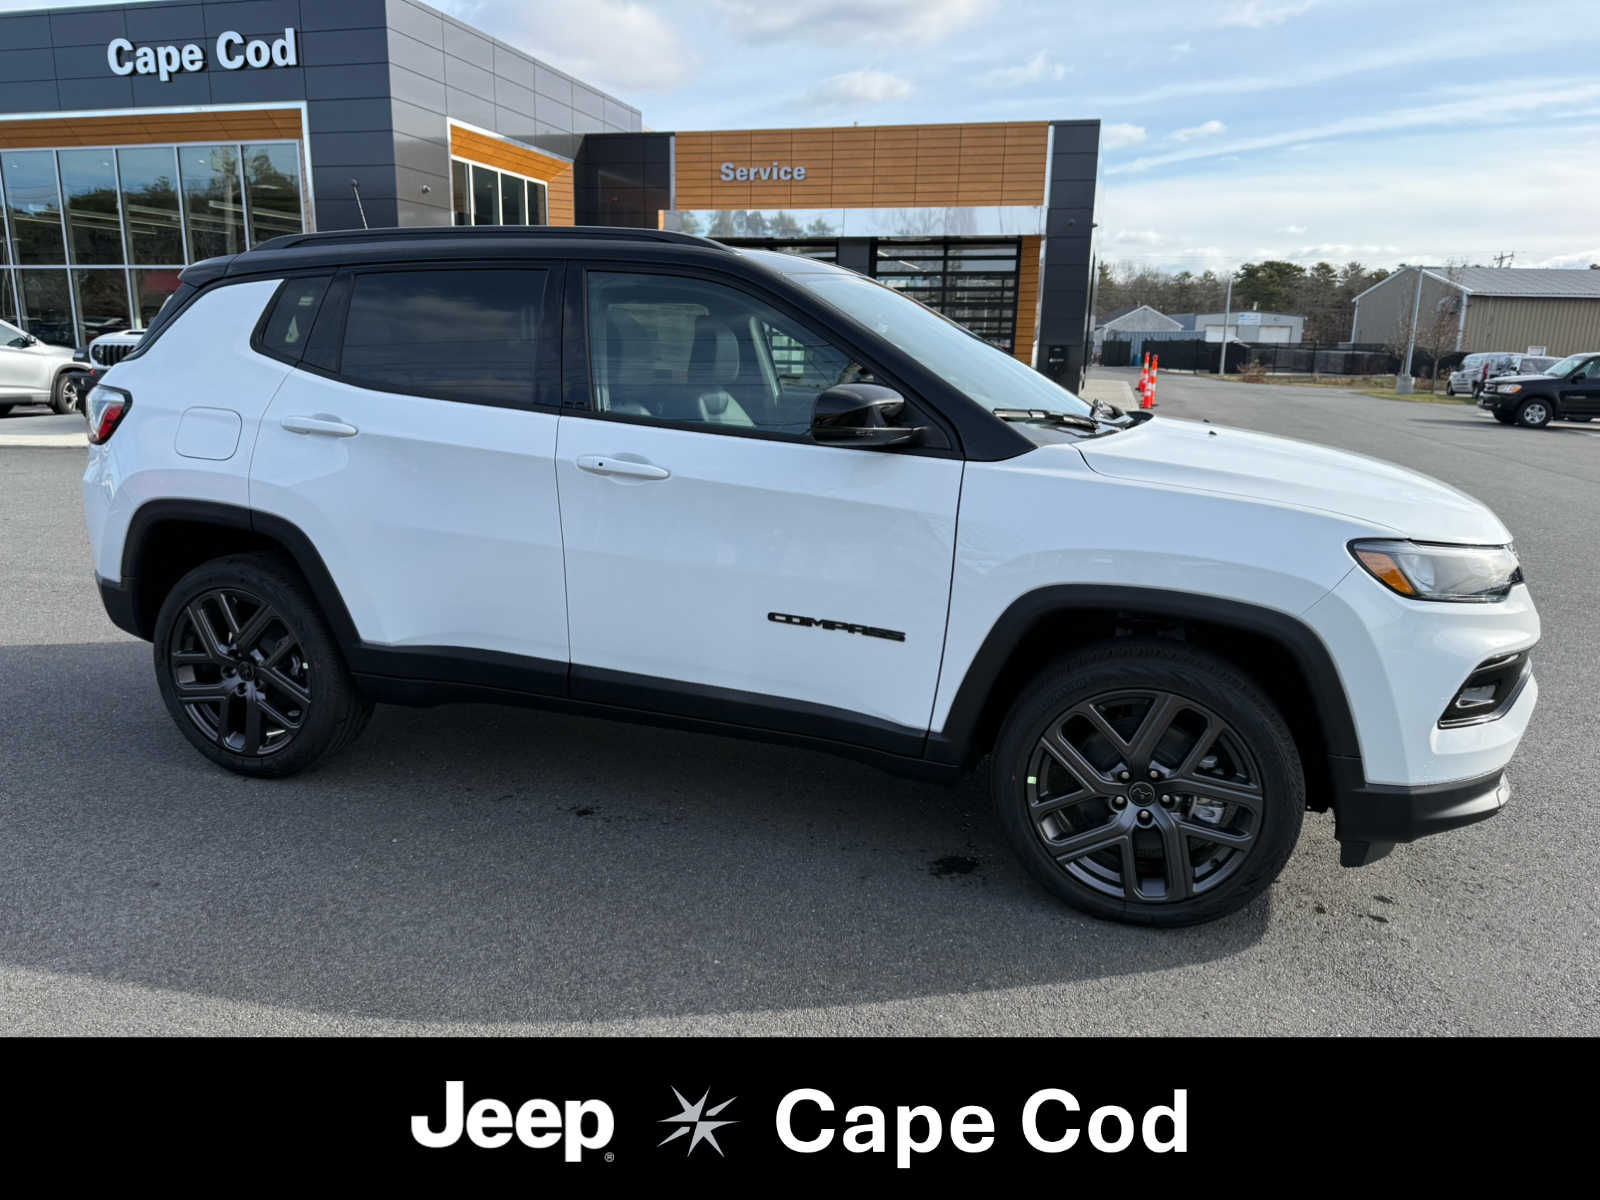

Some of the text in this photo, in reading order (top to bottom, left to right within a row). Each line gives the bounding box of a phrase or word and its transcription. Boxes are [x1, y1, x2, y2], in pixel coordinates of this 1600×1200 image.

[107, 27, 297, 82] Cape Cod
[720, 161, 806, 182] Service
